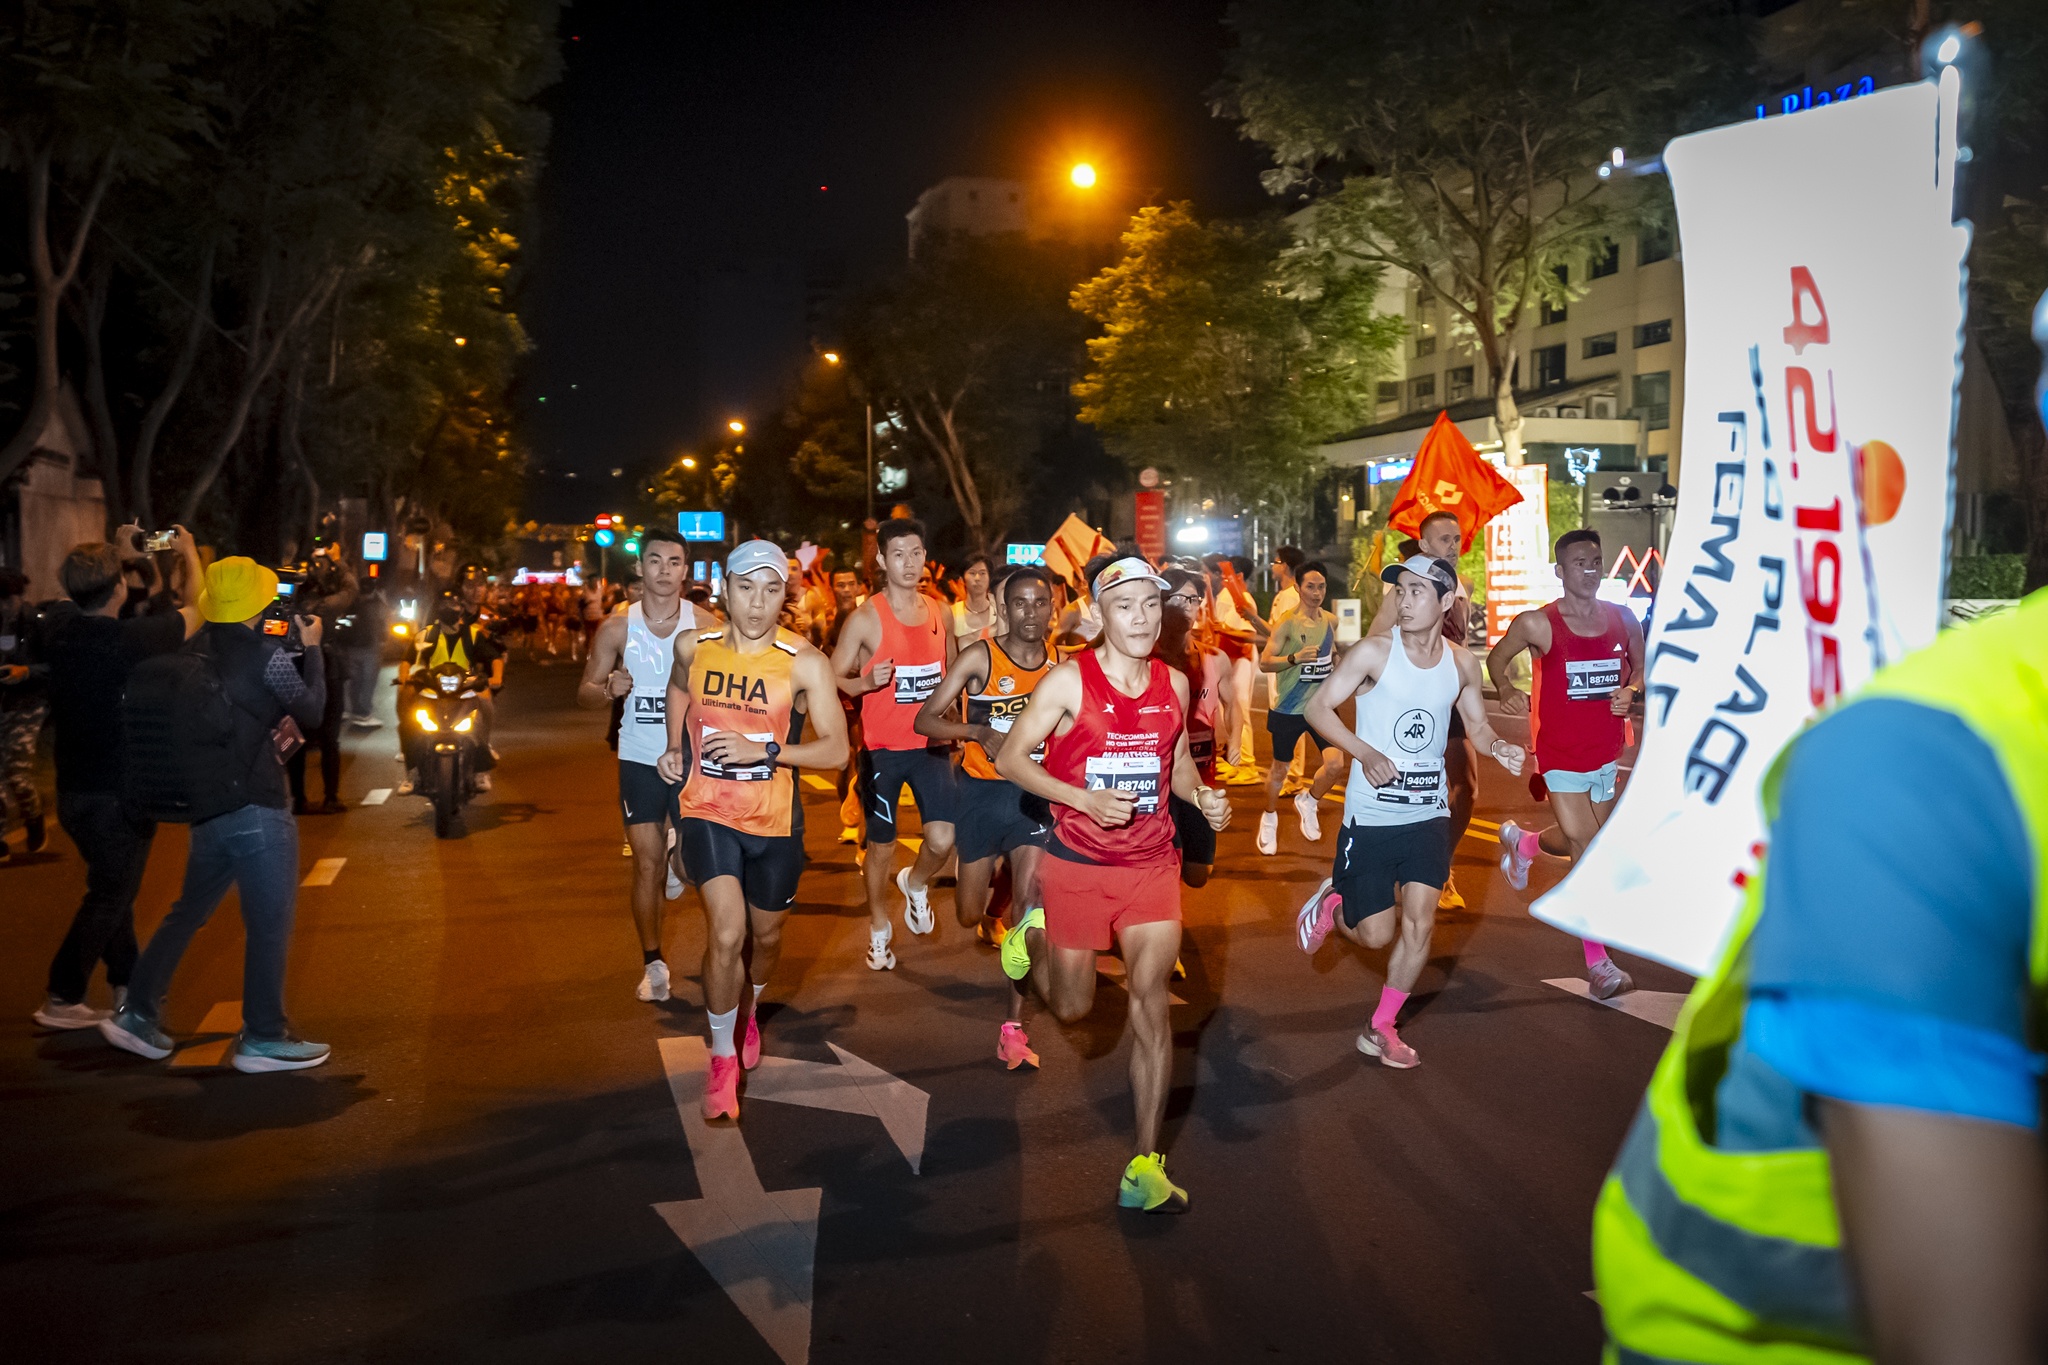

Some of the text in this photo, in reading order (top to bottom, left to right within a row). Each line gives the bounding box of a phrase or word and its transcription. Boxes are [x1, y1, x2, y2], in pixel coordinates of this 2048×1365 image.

[1782, 75, 1875, 115] Plaza
[1304, 665, 1312, 674] C
[899, 678, 911, 690] A
[1571, 675, 1584, 687] A
[1589, 674, 1619, 684] 887403
[1684, 556, 1786, 804] PLACE
[703, 670, 769, 705] DHA
[638, 698, 650, 710] A
[744, 704, 767, 716] Team
[1107, 732, 1159, 740] TECHCOMBANK
[1403, 723, 1426, 739] AR
[1092, 778, 1106, 791] A
[1117, 780, 1156, 791] 887401
[1406, 776, 1439, 786] 940104
